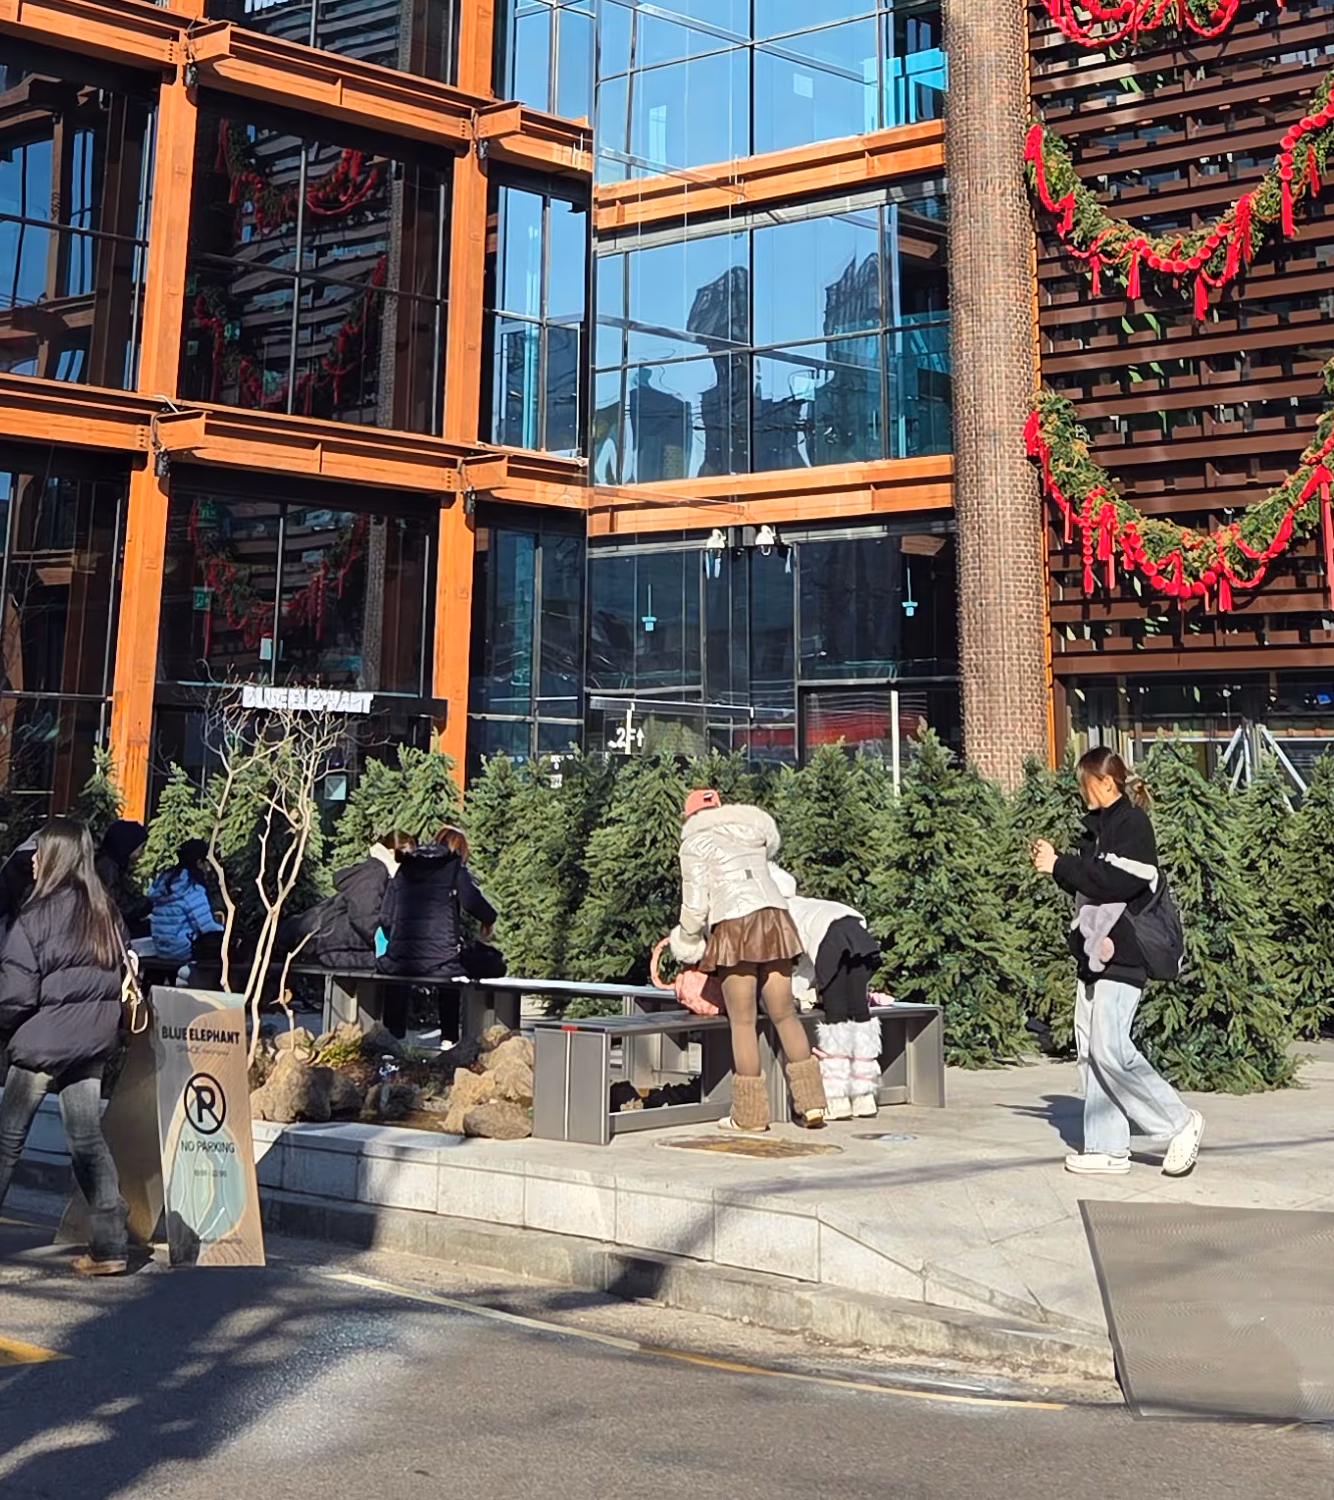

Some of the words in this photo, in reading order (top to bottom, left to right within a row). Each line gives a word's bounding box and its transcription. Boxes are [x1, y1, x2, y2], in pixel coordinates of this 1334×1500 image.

[161, 1026, 188, 1040] BLUE
[189, 1028, 240, 1044] ELEPHANT
[181, 1140, 195, 1152] NO
[196, 1141, 235, 1154] PARKING
